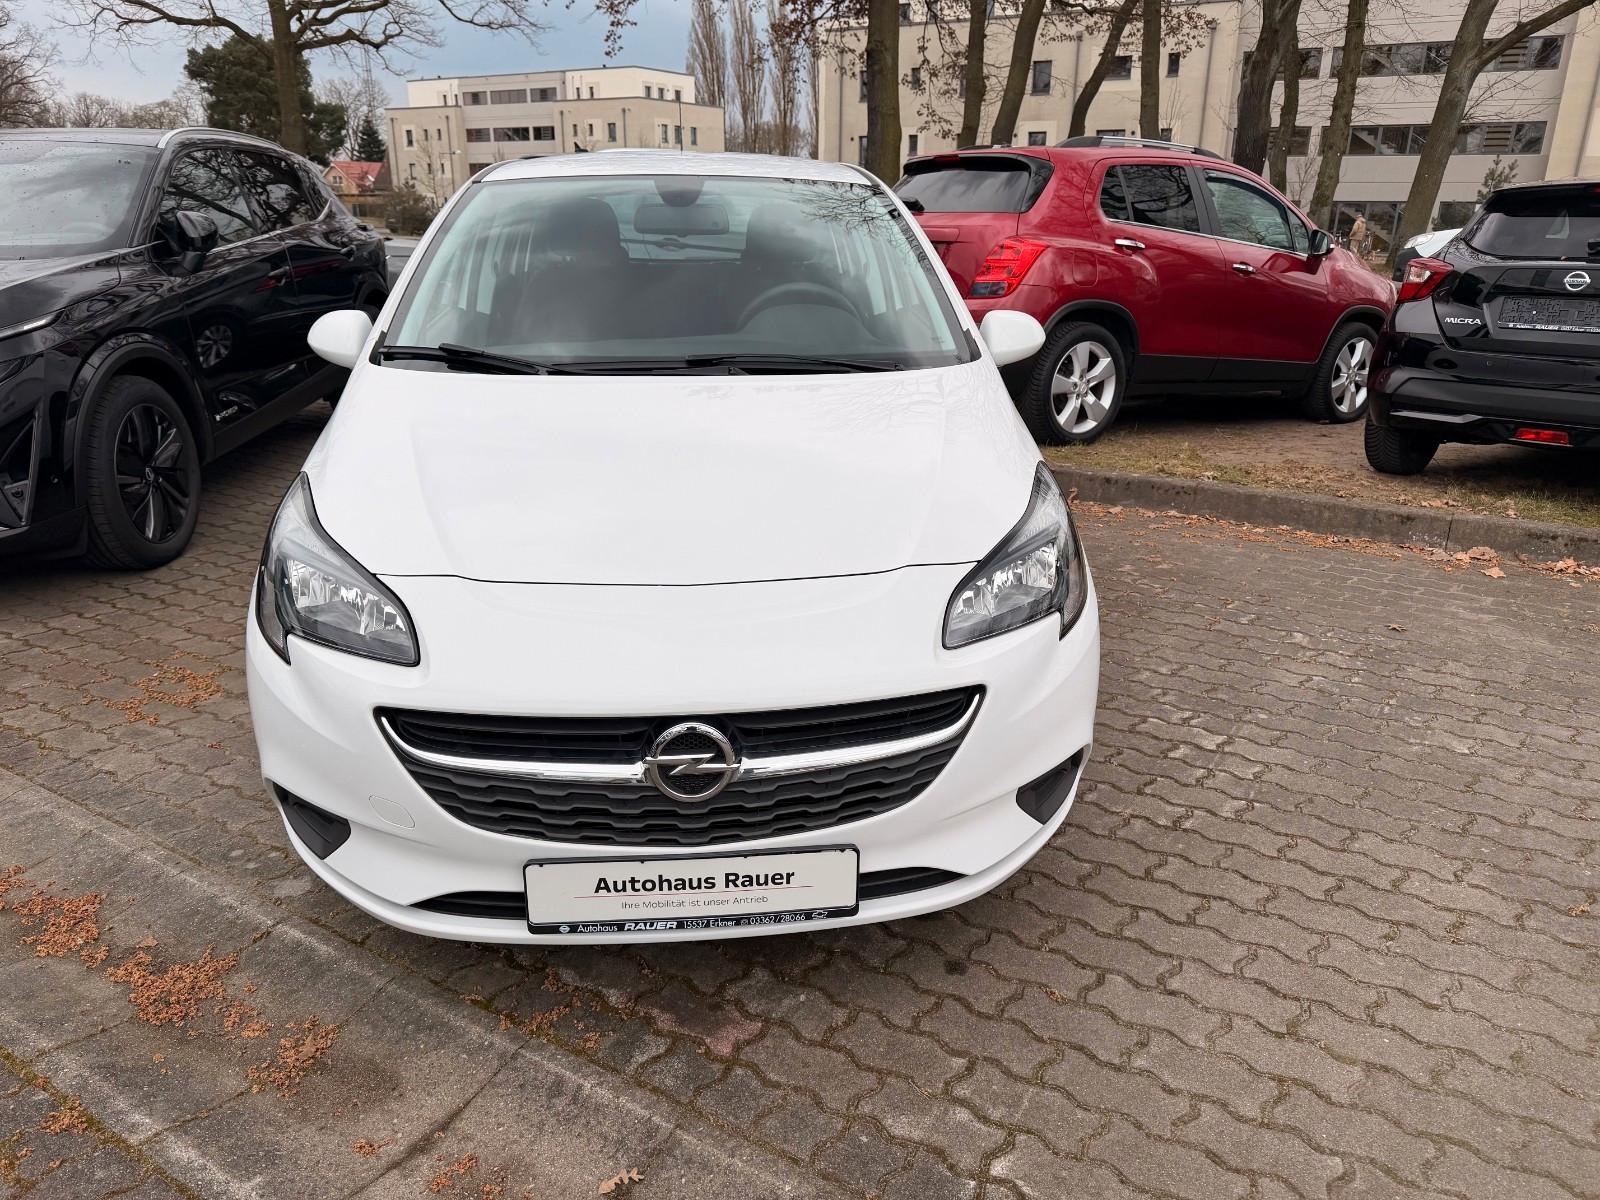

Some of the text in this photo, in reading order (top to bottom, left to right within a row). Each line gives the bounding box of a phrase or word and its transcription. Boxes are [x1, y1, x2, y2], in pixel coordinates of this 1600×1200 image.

[1444, 317, 1481, 325] MICRA
[594, 871, 795, 893] Autohaus Rauer
[621, 895, 768, 909] Ihre Mobilität ist unser Antrieb
[577, 913, 806, 933] Autohaus RAUER 15537 Erkner 03362/28066
